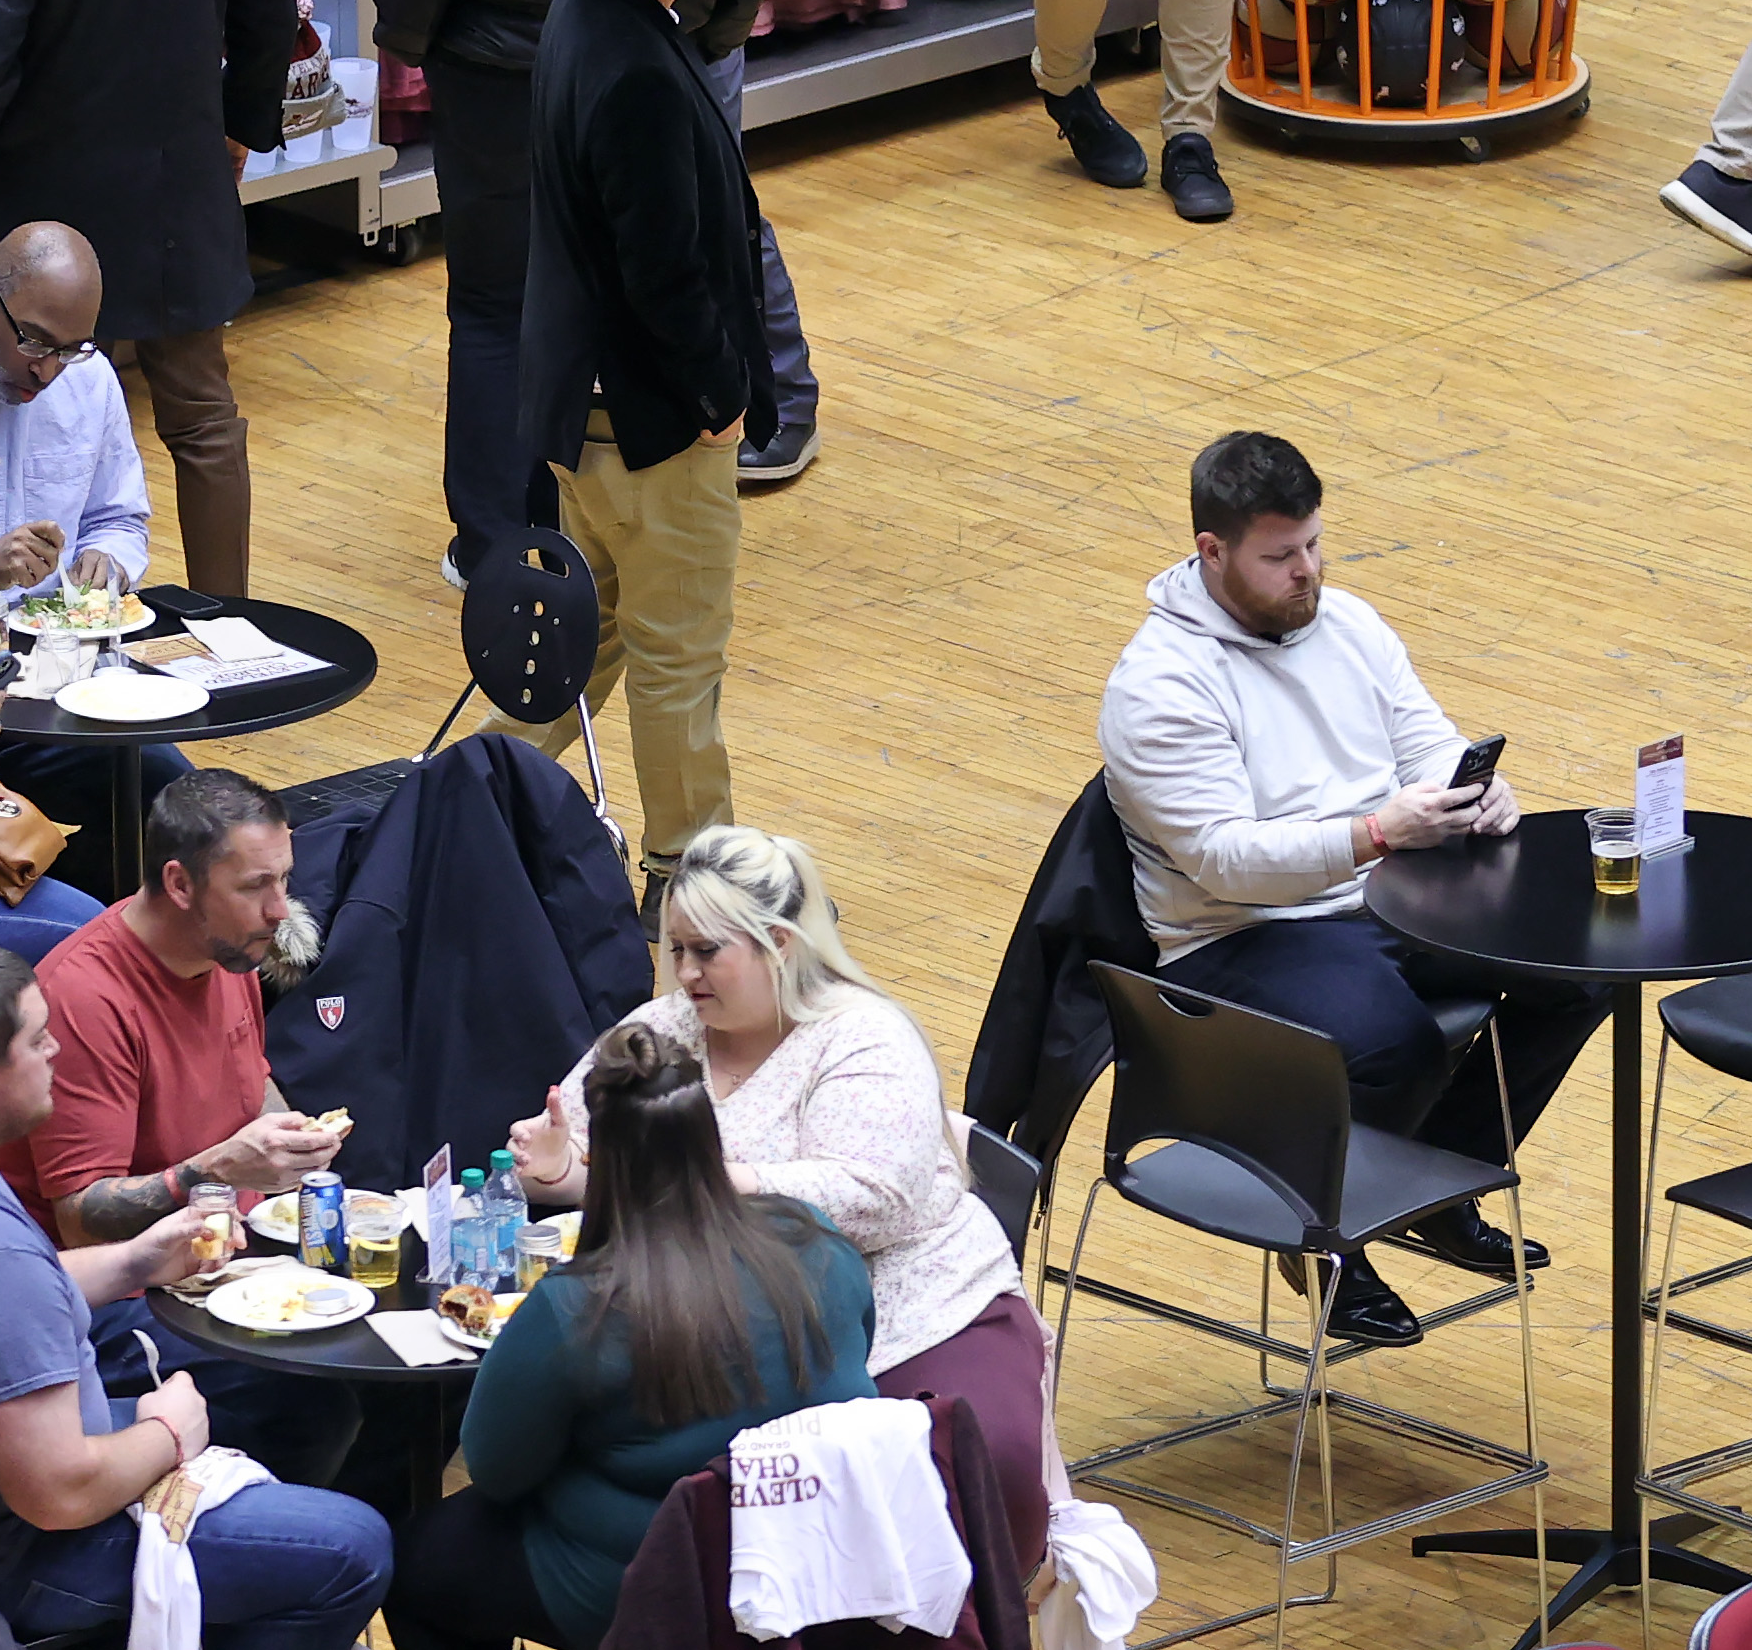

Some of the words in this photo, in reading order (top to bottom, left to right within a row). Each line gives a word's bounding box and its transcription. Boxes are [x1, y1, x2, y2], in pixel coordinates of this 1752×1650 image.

[320, 999, 342, 1008] POLO
[751, 1440, 791, 1451] GRAND
[732, 1453, 799, 1480] CHA
[731, 1474, 821, 1508] CLEVE
